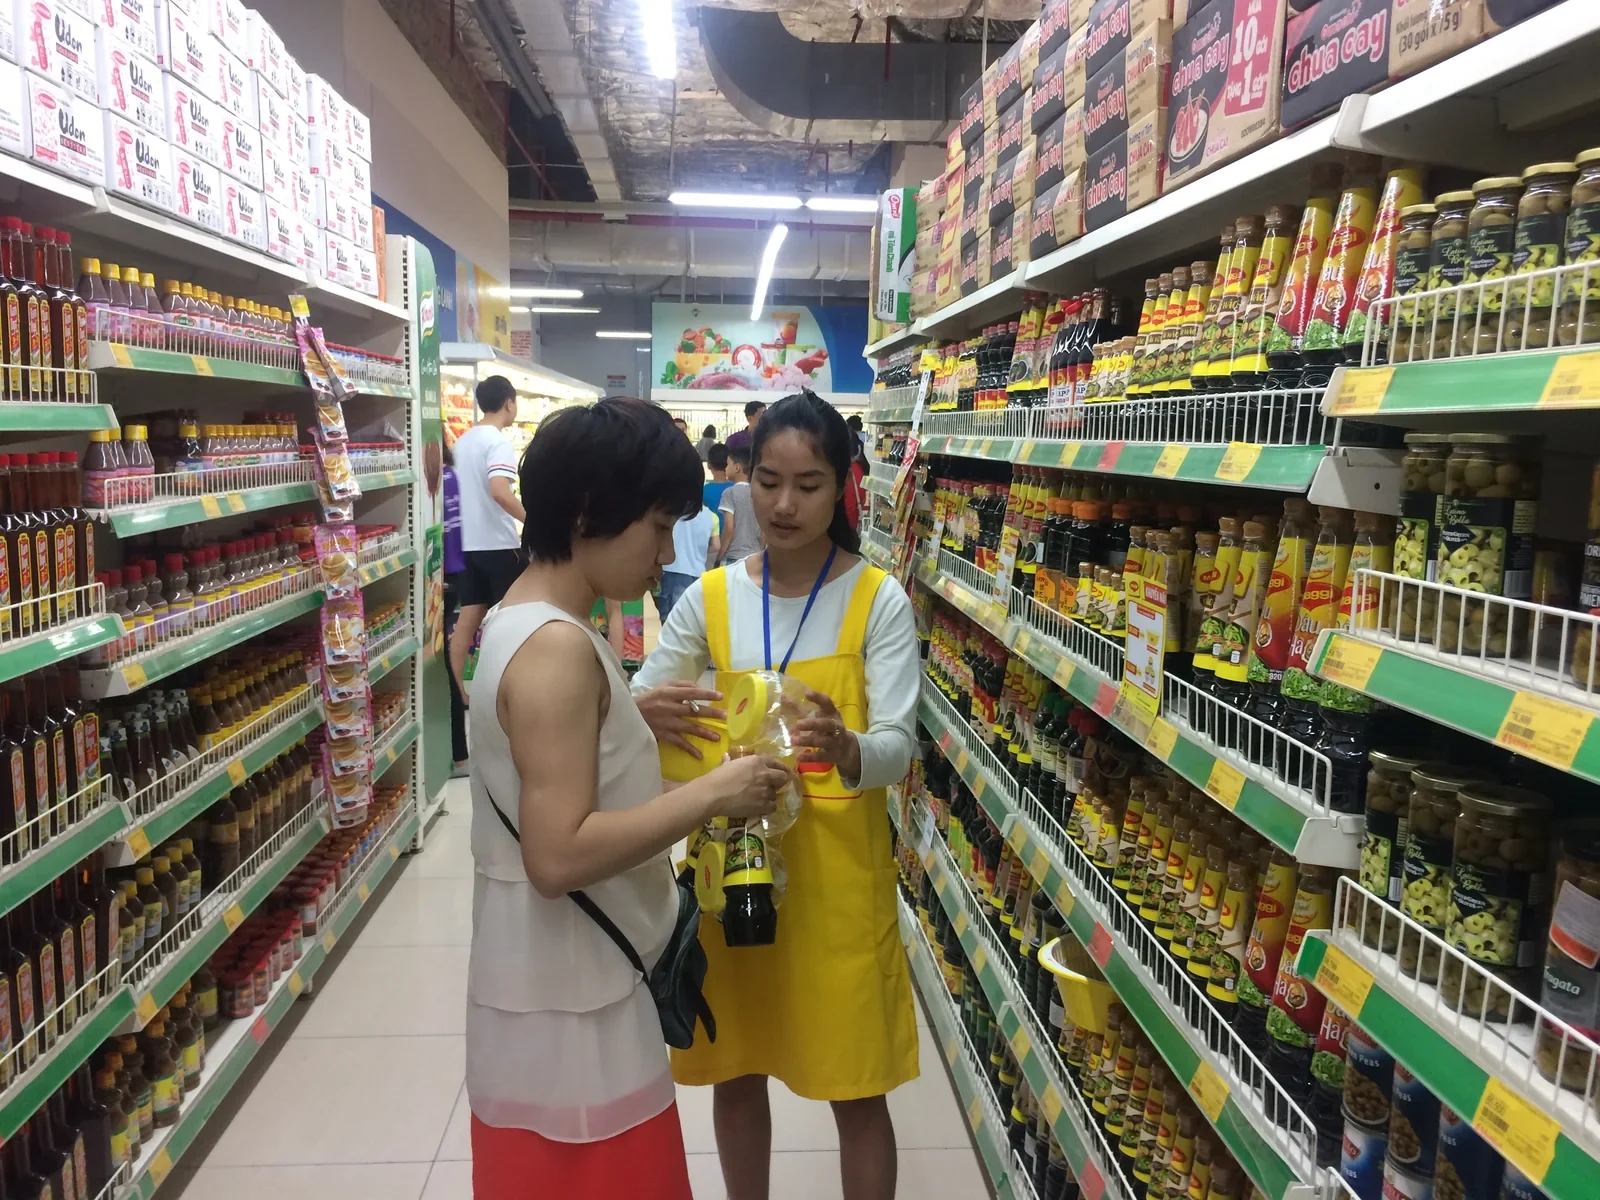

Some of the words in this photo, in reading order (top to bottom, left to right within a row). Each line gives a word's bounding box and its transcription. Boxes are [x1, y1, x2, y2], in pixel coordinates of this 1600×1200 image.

[1054, 0, 1068, 29] cay
[1086, 21, 1109, 59] chua
[1109, 1, 1128, 38] cay
[55, 13, 82, 52] Udon
[186, 32, 203, 59] Udon
[1232, 16, 1258, 65] 10
[1172, 54, 1203, 96] chua
[1204, 33, 1230, 72] cay
[1288, 38, 1340, 94] chua
[1340, 8, 1387, 63] cay
[130, 60, 152, 94] Udon
[1049, 71, 1063, 100] cay
[1240, 60, 1253, 106] 1
[190, 98, 209, 126] Udon
[1107, 84, 1126, 120] cay
[58, 108, 86, 142] Udon
[236, 128, 252, 152] Udon
[136, 138, 160, 170] Udon
[1049, 141, 1062, 170] cay
[193, 168, 211, 195] Udon
[1087, 178, 1108, 210] chua
[1108, 166, 1126, 201] cay
[238, 192, 253, 215] Udon
[1359, 1054, 1380, 1068] Peas
